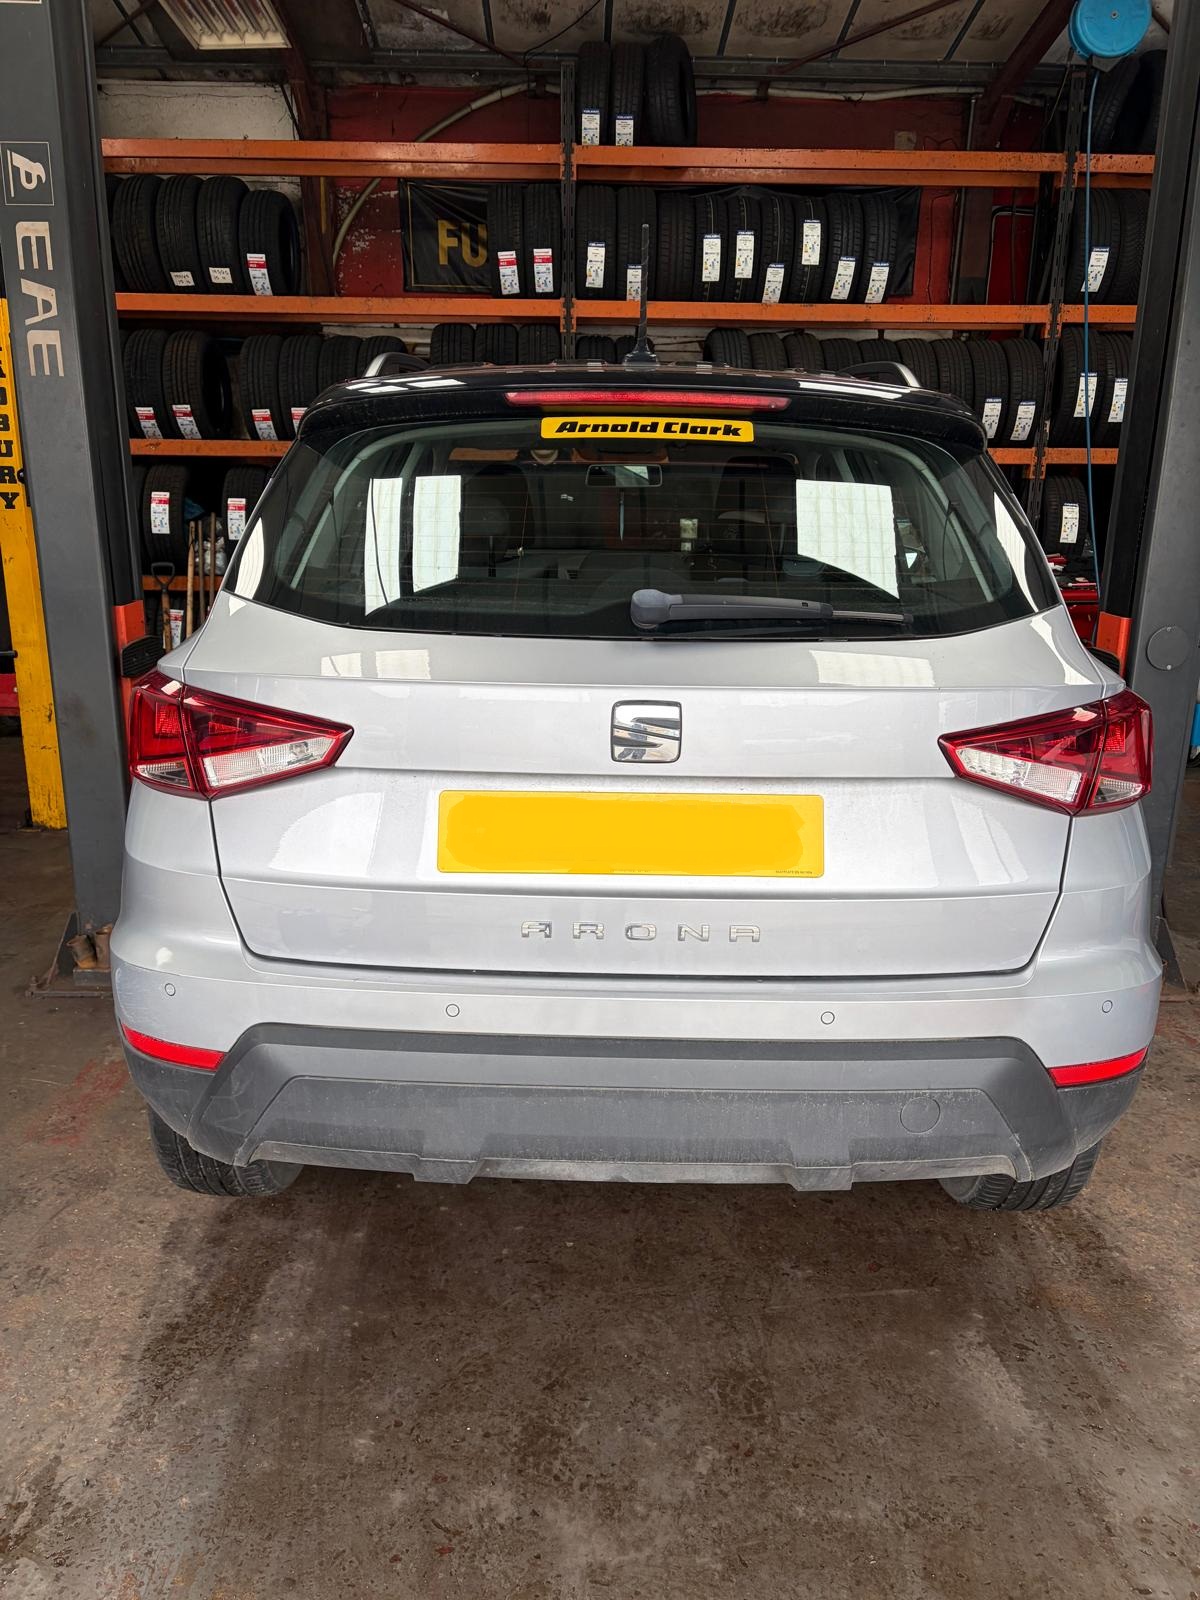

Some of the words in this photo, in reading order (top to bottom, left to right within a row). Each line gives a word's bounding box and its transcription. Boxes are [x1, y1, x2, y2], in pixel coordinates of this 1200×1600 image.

[15, 221, 65, 377] EAE
[555, 421, 659, 433] Arnold
[663, 422, 742, 437] Clark
[521, 920, 761, 942] ARONA
